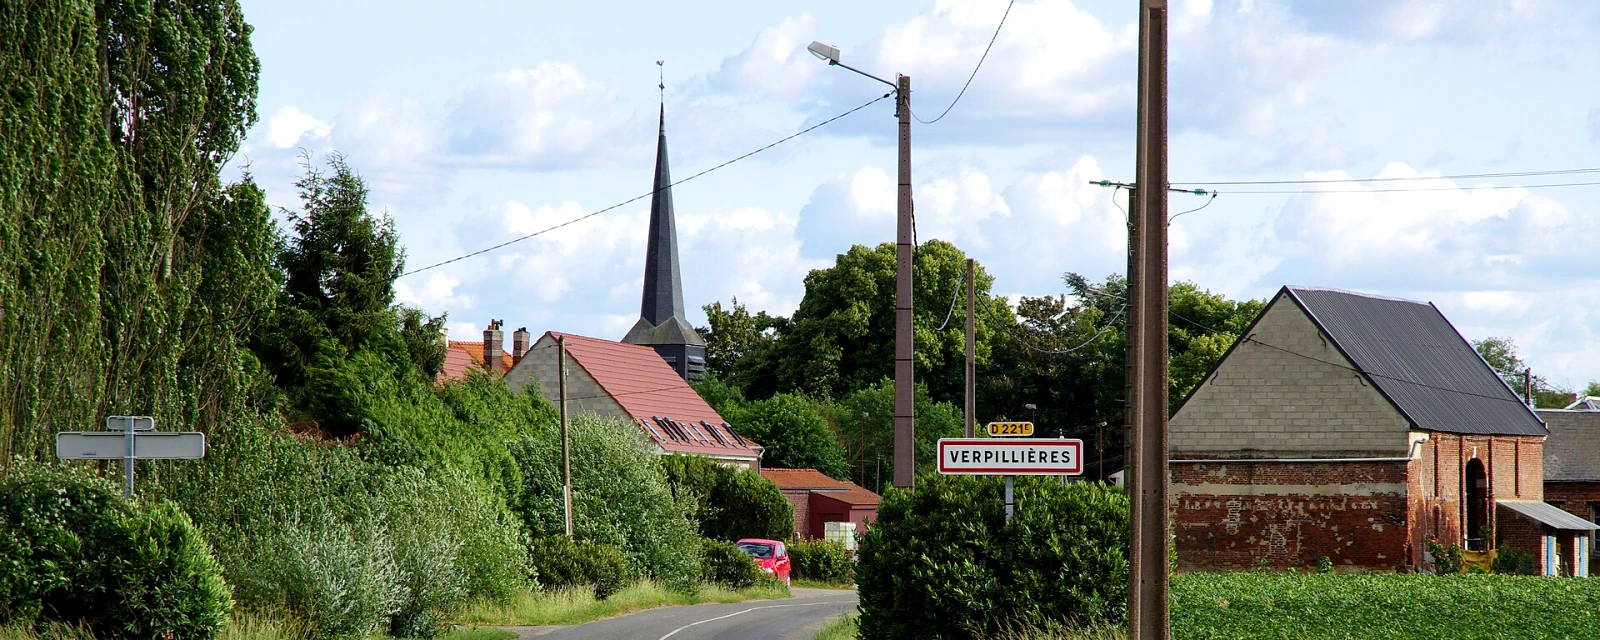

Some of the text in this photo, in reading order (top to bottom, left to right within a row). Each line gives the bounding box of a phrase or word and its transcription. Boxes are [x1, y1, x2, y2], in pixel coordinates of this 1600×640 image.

[991, 424, 1030, 434] D 221E
[950, 448, 1070, 463] VERPILLIÈRES
